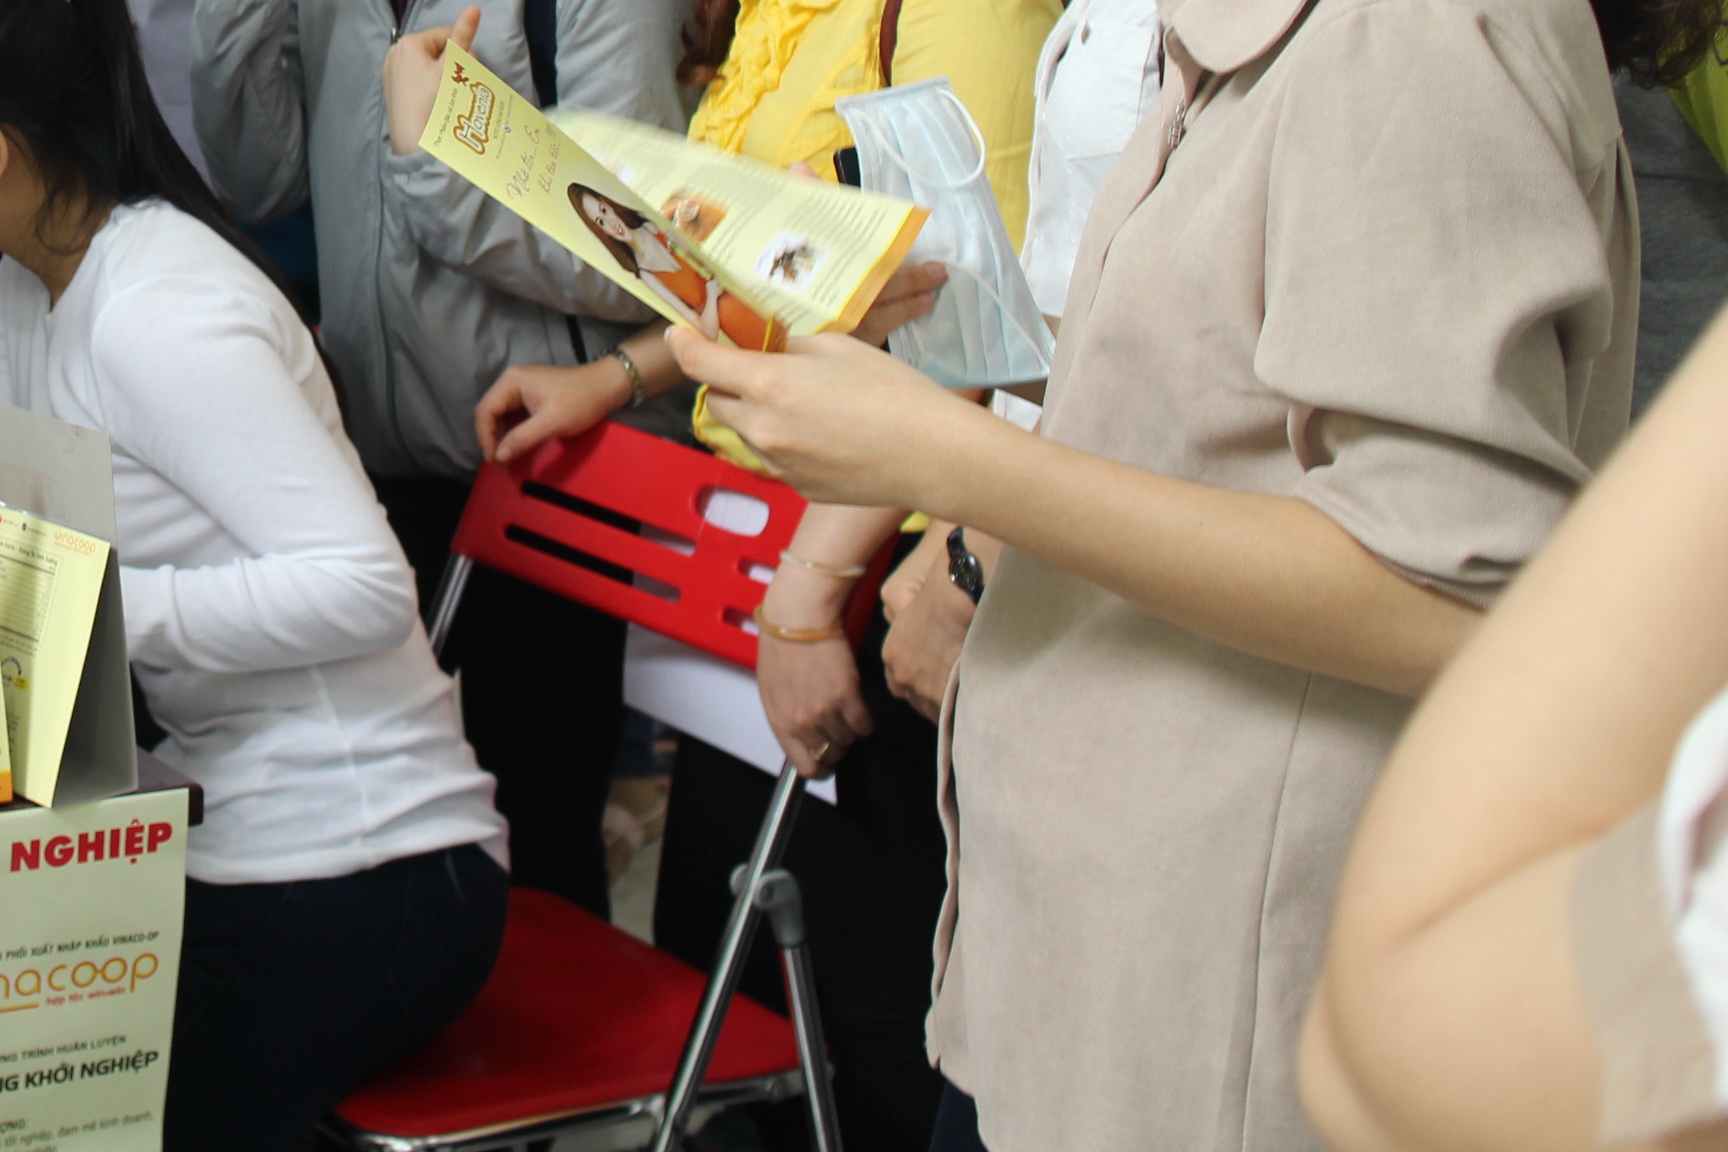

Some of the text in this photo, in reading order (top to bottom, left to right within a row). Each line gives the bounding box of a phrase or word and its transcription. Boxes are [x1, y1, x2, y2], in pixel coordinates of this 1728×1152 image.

[10, 819, 172, 872] NGHIỆP
[25, 1063, 75, 1089] KHỞI
[80, 1049, 159, 1081] NGHIỆP
